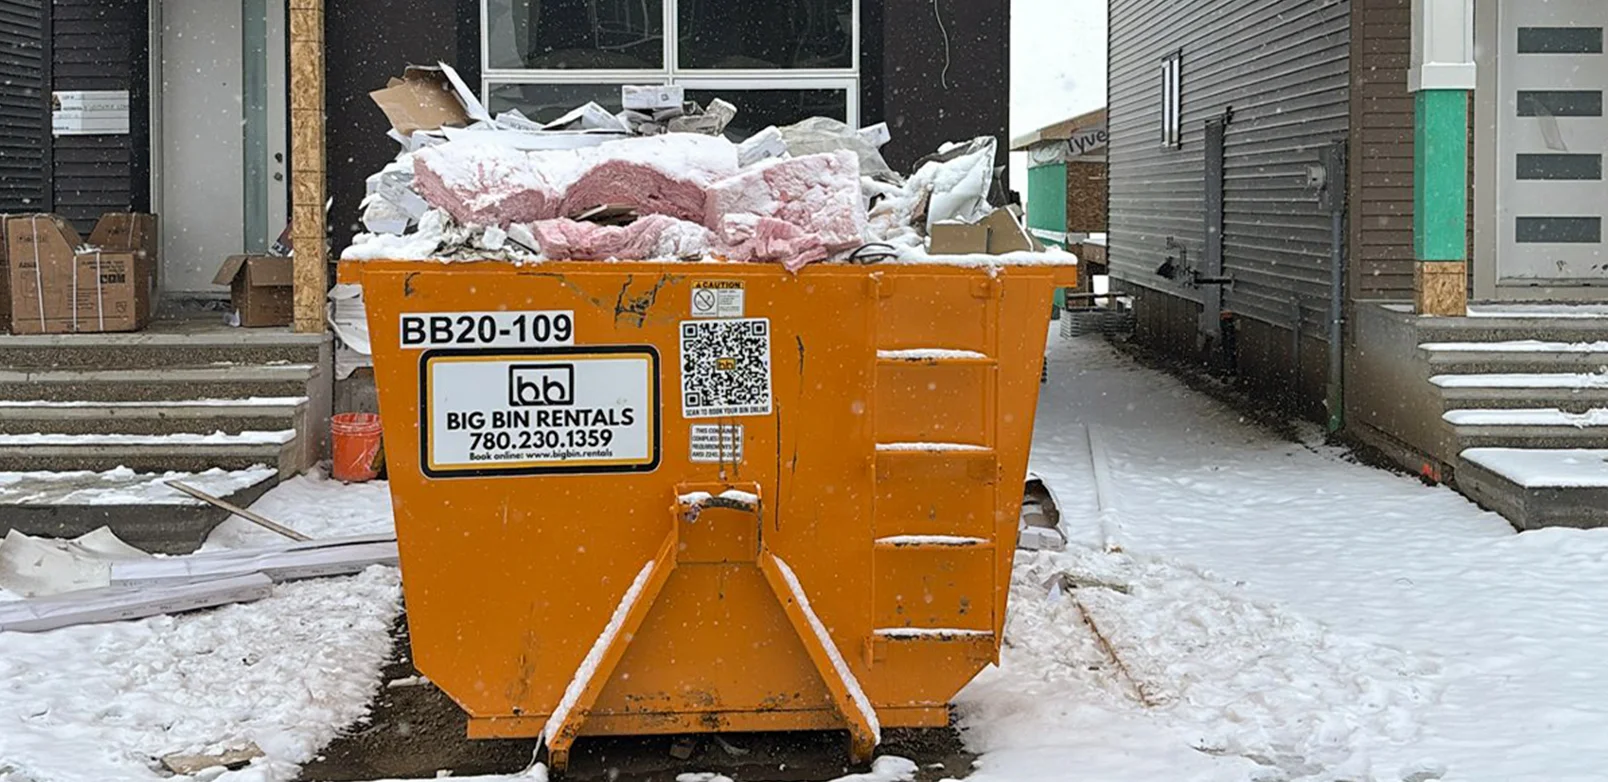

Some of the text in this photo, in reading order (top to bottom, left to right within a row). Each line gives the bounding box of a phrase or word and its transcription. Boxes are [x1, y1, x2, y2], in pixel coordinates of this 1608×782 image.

[1066, 130, 1107, 154] Tyve
[703, 281, 740, 289] CAUTION
[402, 314, 572, 345] BB20-109
[447, 408, 635, 430] BIG BIN RENTALS
[470, 429, 613, 451] 780.230.1359
[469, 448, 613, 461] Book online: www.bigbin.rentals
